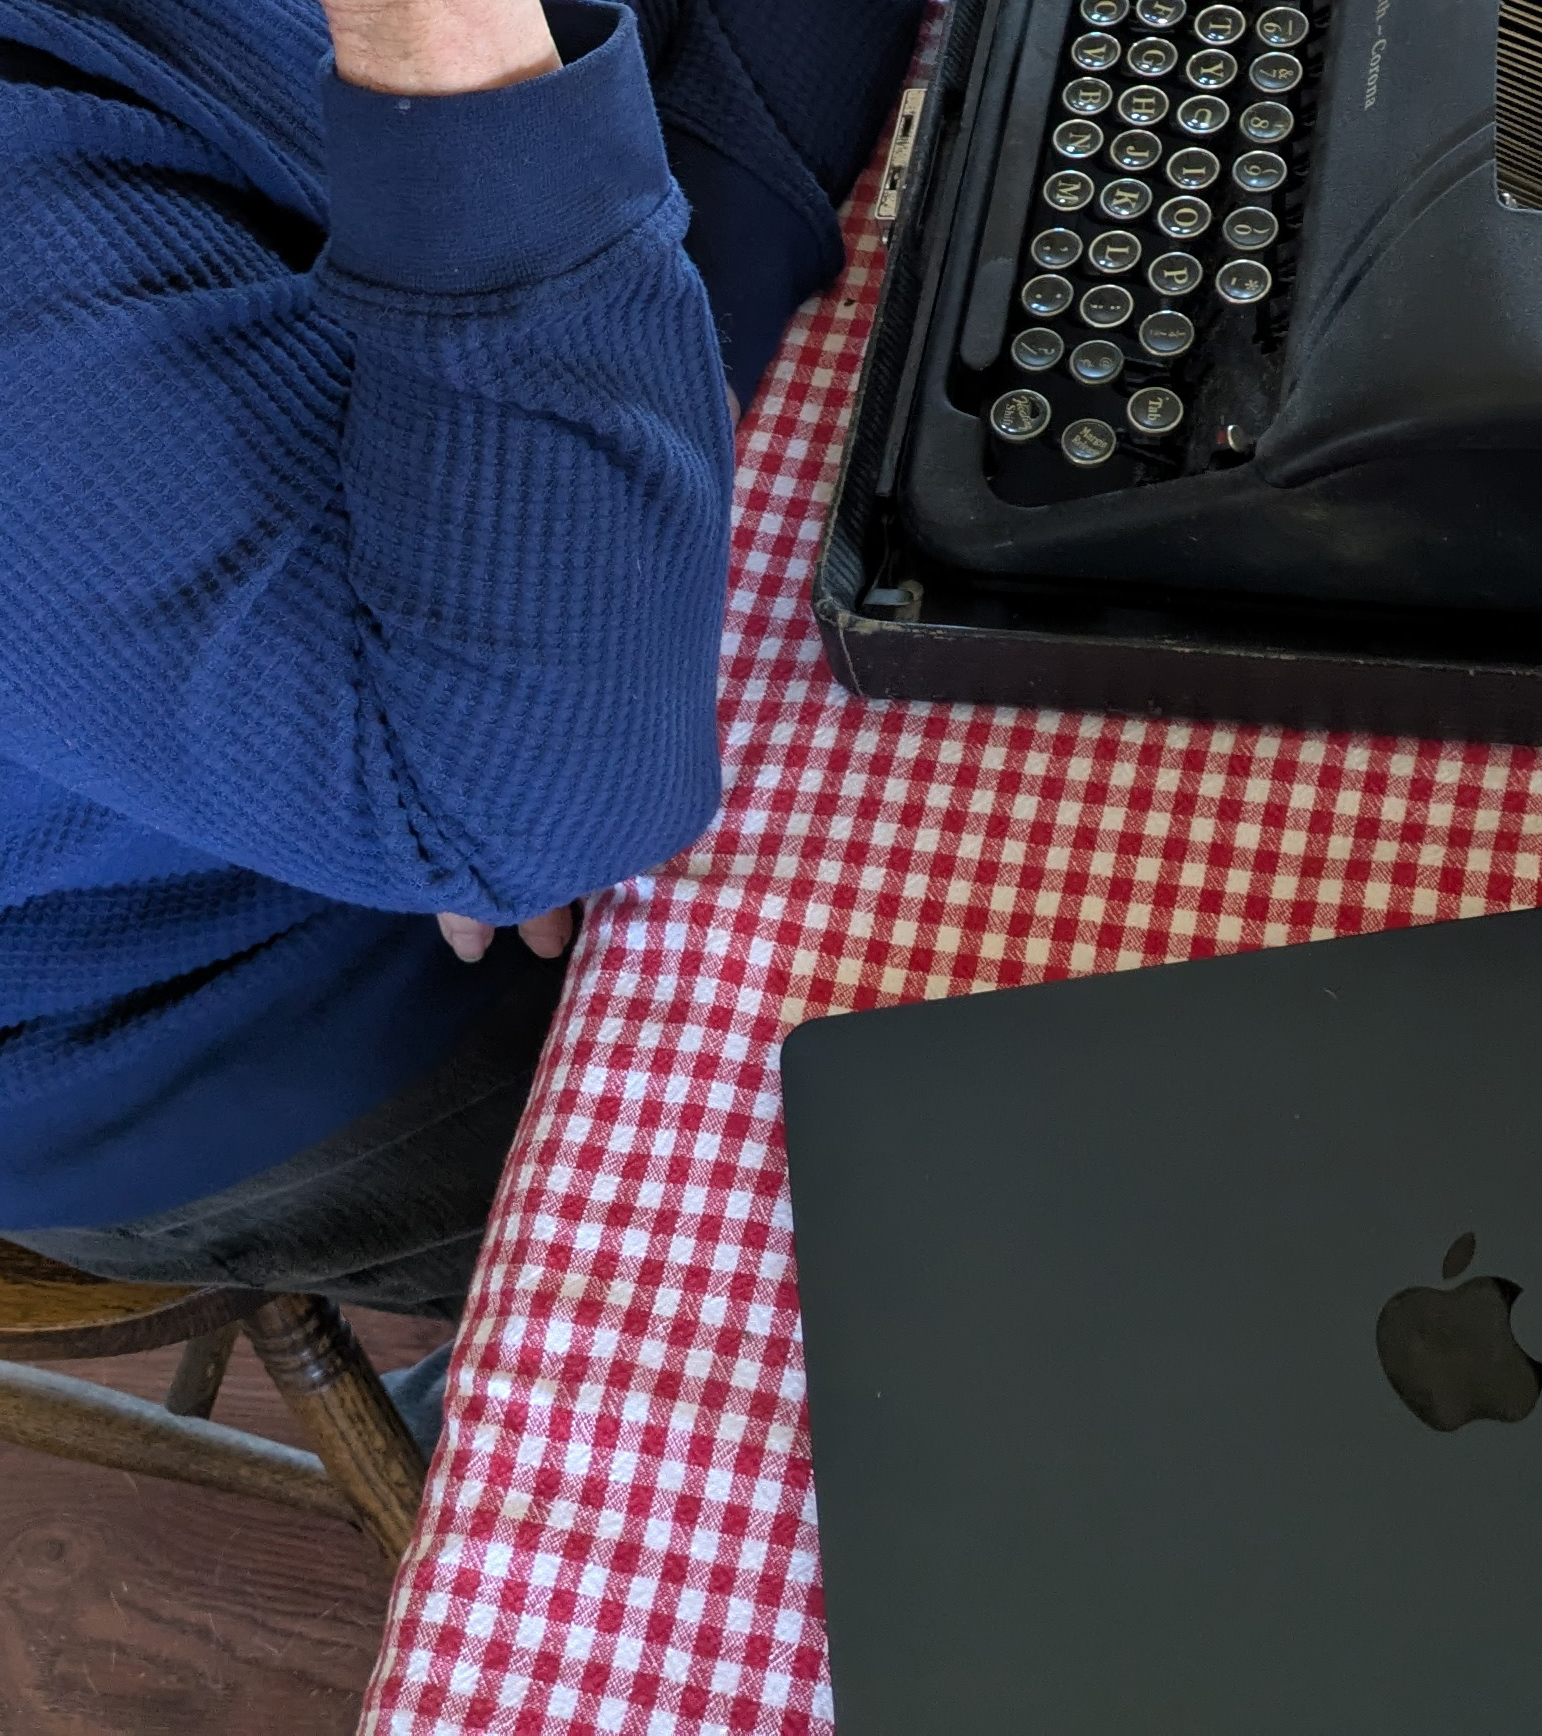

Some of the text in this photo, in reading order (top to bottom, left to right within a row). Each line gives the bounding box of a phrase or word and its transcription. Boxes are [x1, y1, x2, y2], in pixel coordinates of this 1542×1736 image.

[1097, 0, 1117, 14] C
[1153, 0, 1175, 18] F
[1209, 18, 1233, 36] T
[1263, 22, 1283, 34] 6
[1081, 44, 1107, 60] V
[1141, 48, 1165, 66] G
[1199, 62, 1223, 78] Y
[1259, 68, 1277, 78] 7
[1277, 68, 1293, 80] &
[1364, 38, 1387, 111] Corona
[1079, 90, 1101, 104] B
[1133, 98, 1155, 114] H
[1195, 108, 1213, 124] U
[1249, 116, 1269, 128] 8
[1069, 132, 1091, 148] N
[1125, 144, 1149, 158] J
[1181, 166, 1207, 176] I
[1243, 164, 1261, 176] 9
[1057, 180, 1081, 204] M
[1115, 190, 1139, 208] K
[1173, 206, 1199, 226] O
[1233, 224, 1253, 236] 0
[1107, 244, 1131, 262] L
[1163, 266, 1189, 286] P
[1148, 396, 1164, 421] Tab
